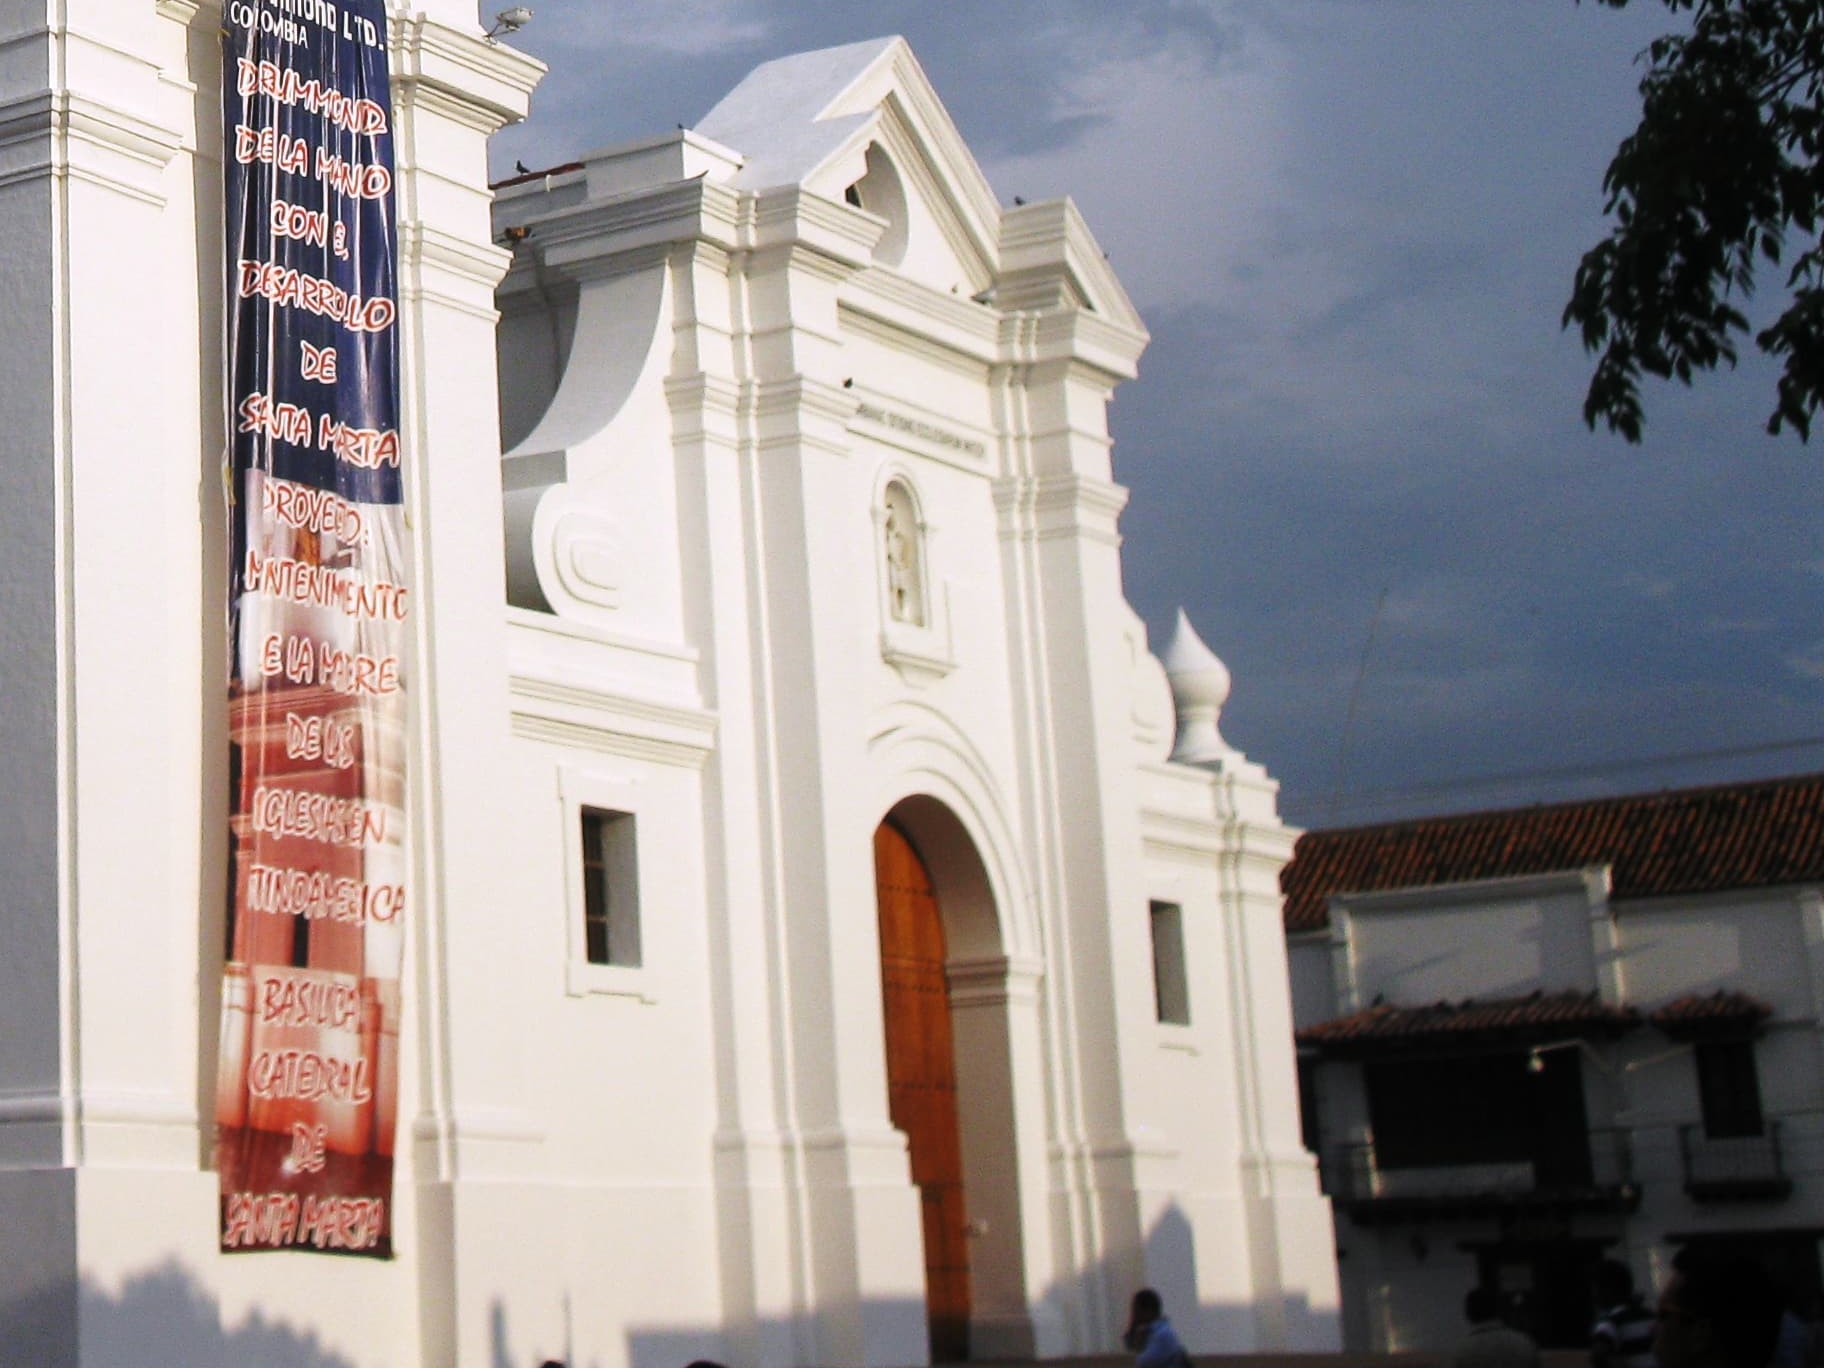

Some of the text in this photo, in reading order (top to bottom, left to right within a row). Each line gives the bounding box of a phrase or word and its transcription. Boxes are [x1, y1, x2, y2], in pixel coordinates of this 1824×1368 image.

[343, 11, 384, 51] LTD.
[235, 125, 391, 199] DE LA MANO
[271, 200, 328, 248] CON
[300, 340, 337, 383] DE
[238, 392, 400, 469] SANTA MARTA
[286, 635, 314, 684] LA
[286, 711, 321, 760] DE
[292, 1122, 327, 1174] DE
[223, 1192, 384, 1249] SANTA MARTA
